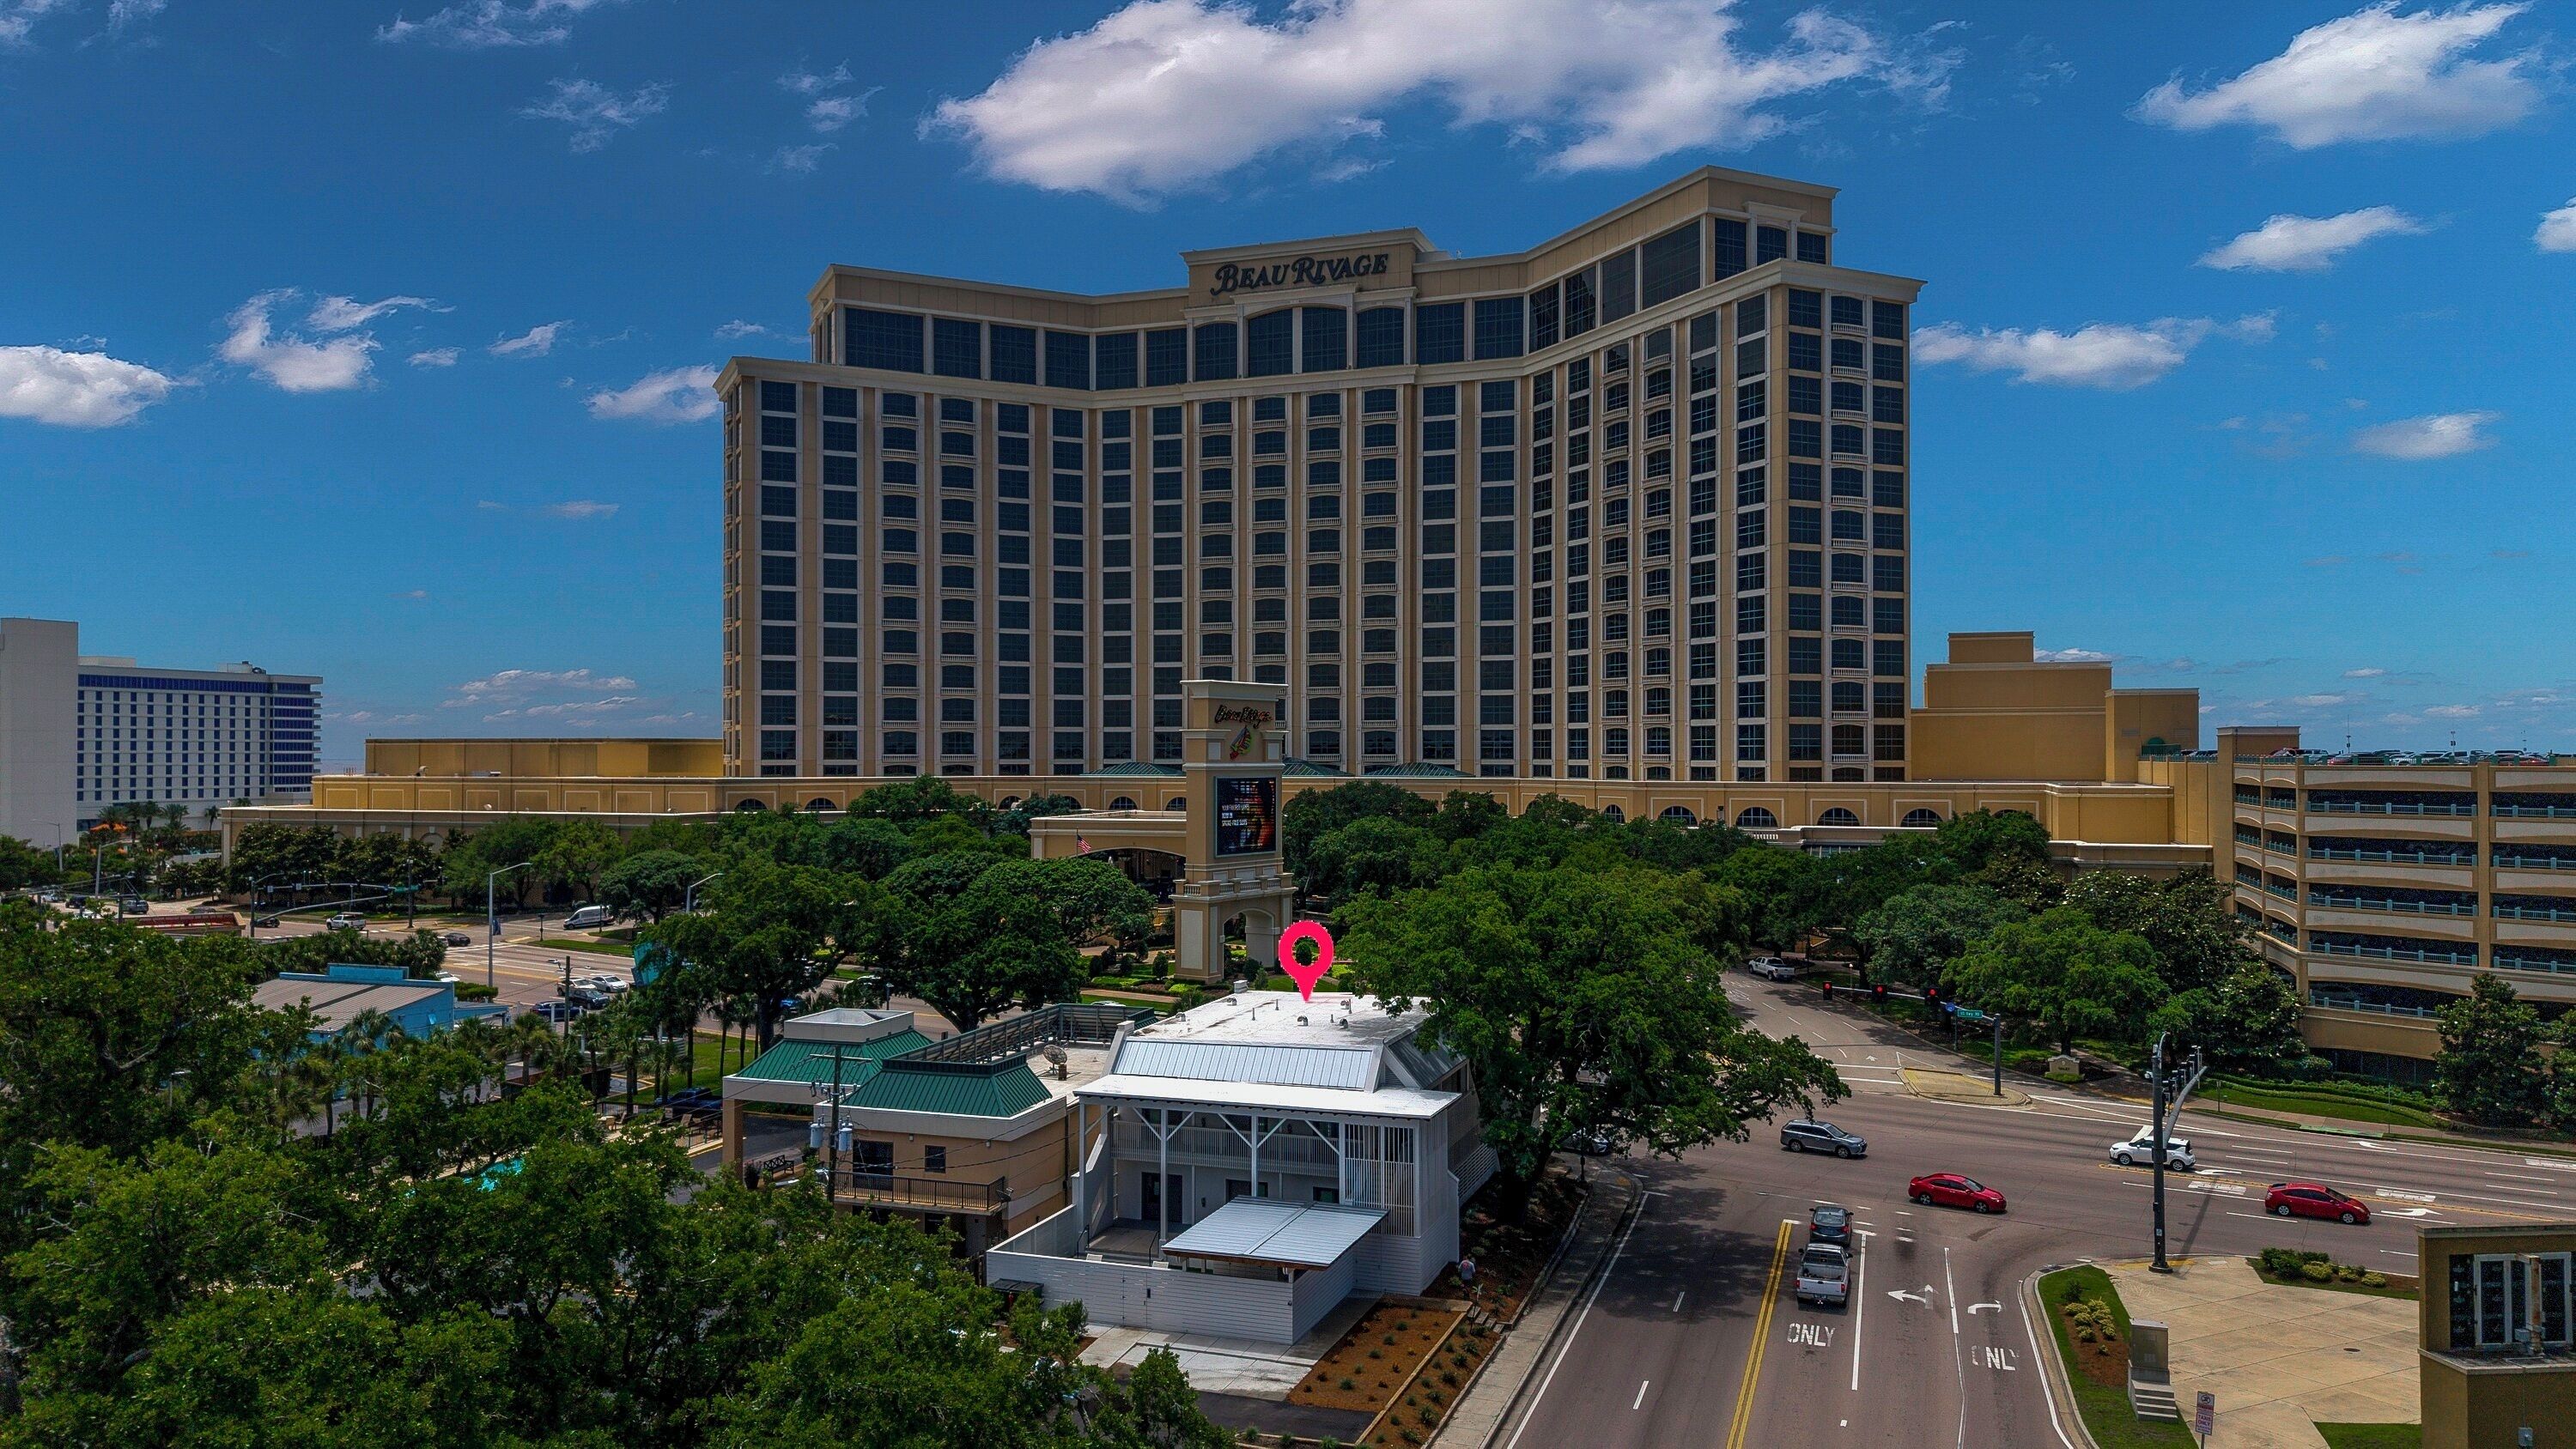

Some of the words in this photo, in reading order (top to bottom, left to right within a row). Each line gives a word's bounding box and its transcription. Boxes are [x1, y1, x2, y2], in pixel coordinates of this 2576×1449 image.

[1210, 264, 1290, 295] BEAU
[1291, 253, 1388, 284] RIVAGE
[1787, 1323, 1836, 1347] ONLY
